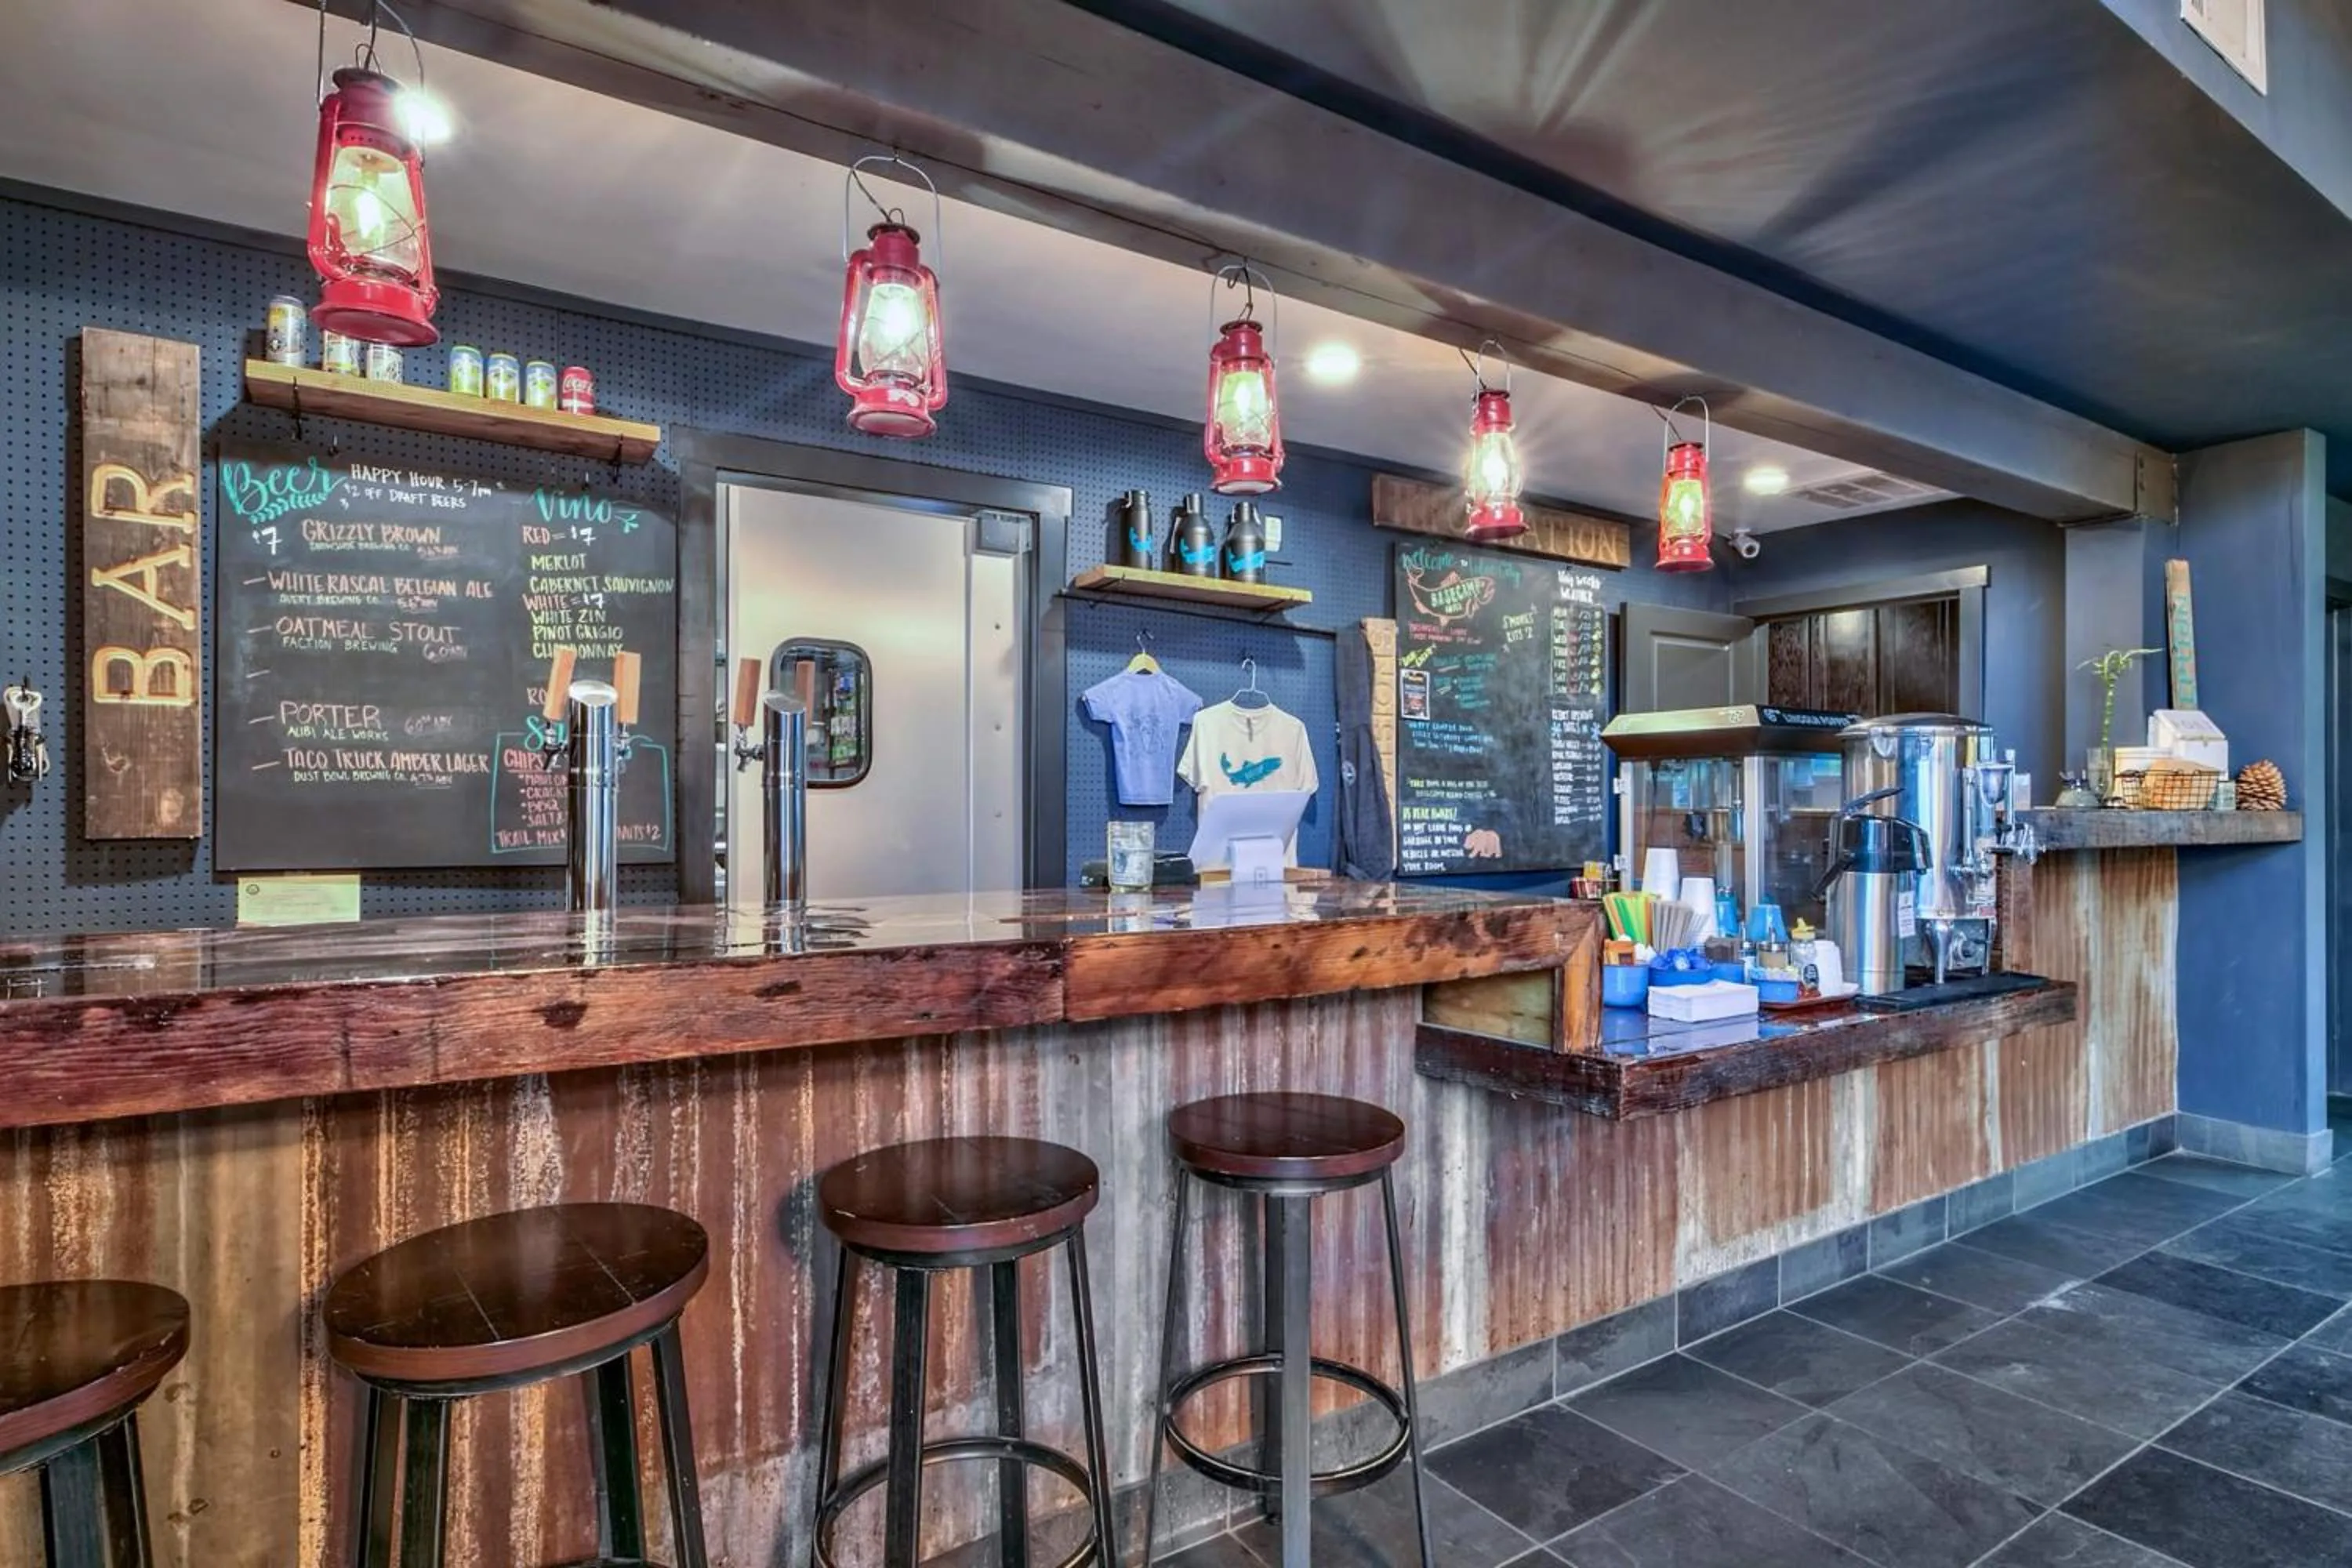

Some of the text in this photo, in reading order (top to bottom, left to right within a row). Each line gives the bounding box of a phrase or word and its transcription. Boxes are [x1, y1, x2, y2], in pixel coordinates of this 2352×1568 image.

[223, 457, 343, 514] Beer
[351, 463, 401, 485] HAPPY
[409, 472, 445, 491] HOUR
[365, 487, 382, 501] OFF
[390, 489, 426, 506] DRAFT
[431, 495, 466, 509] BEERS
[535, 488, 612, 523] Vino
[252, 526, 282, 555] $7
[301, 518, 441, 544] GRIZZLY BROWN
[522, 524, 550, 544] RED
[531, 553, 586, 571] MERLOT
[91, 463, 195, 704] BAR
[267, 571, 492, 598] WHITE RASCAL BELGIAN ALE
[529, 575, 675, 593] CABERNET SAUVIGNON
[317, 595, 362, 605] BREWING
[522, 593, 568, 611] WHITE
[532, 609, 606, 625] WHITE ZIN
[276, 615, 460, 643] OATMEAL STOUT
[533, 624, 624, 640] PINOT GRIGIO
[283, 637, 397, 653] FACTION BREWING
[281, 701, 382, 729] PORTER
[287, 726, 389, 741] ALIBI ALE WORKS
[283, 747, 490, 773] TACO TRUCK AMBER LAGER
[503, 749, 543, 768] CHIPS
[294, 771, 319, 782] DUST
[324, 771, 350, 782] BOWL
[353, 771, 392, 782] BREWING
[496, 831, 532, 847] TRAIL
[537, 829, 559, 844] MIX
